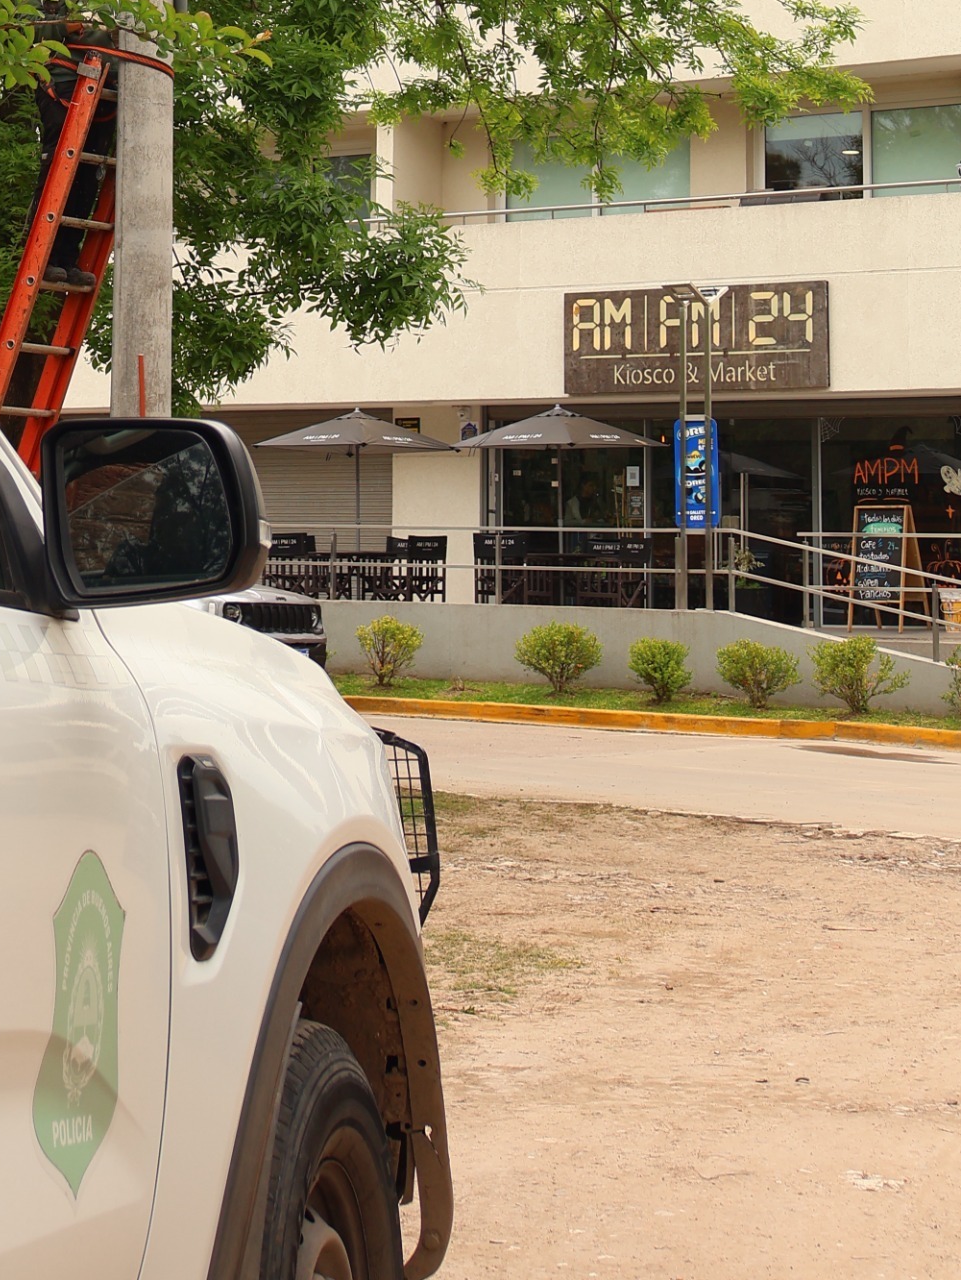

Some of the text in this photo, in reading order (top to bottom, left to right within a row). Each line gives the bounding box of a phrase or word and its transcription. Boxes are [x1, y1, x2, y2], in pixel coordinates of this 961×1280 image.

[572, 297, 632, 352] AM
[748, 290, 813, 346] 24
[613, 360, 777, 386] Kiosco & Market
[853, 457, 919, 485] AMPM
[61, 889, 114, 993] PROVINCIA DE BUENOS AIRES
[52, 1114, 93, 1148] POLICIA
